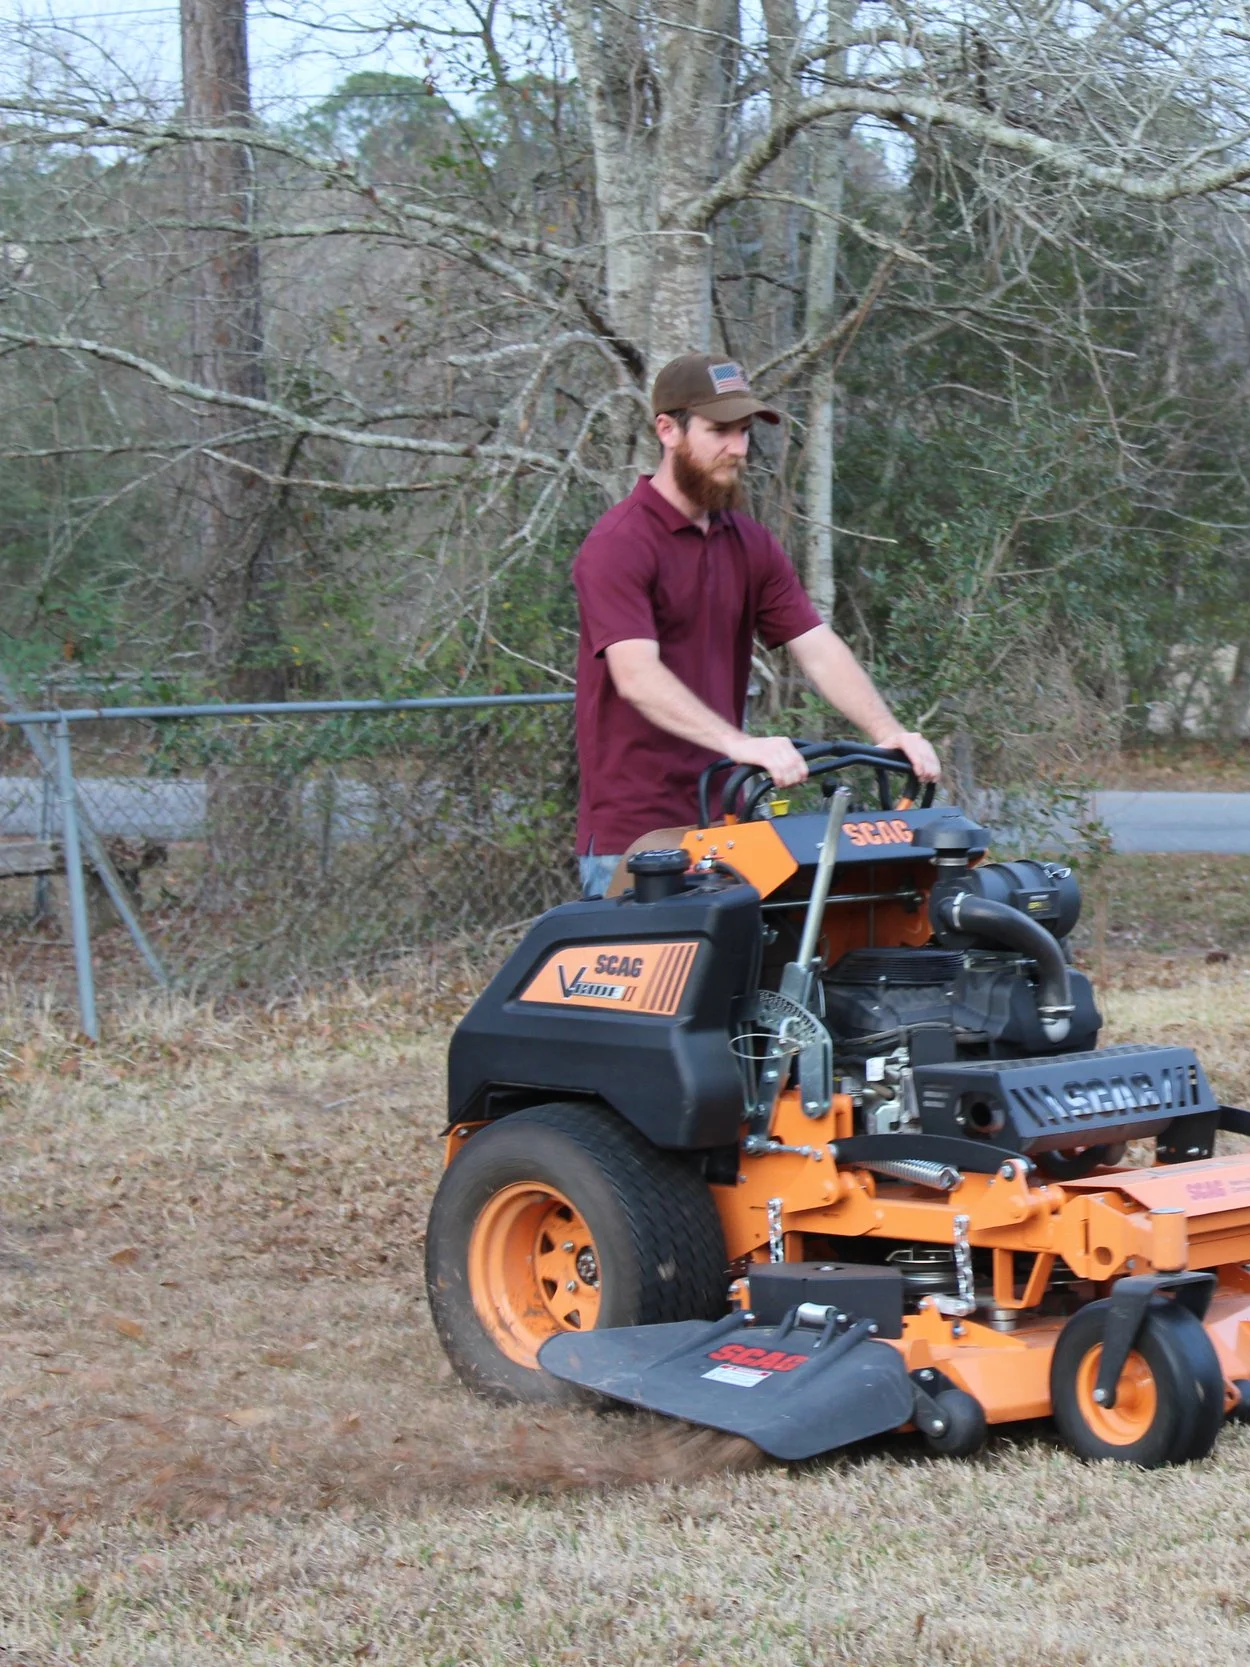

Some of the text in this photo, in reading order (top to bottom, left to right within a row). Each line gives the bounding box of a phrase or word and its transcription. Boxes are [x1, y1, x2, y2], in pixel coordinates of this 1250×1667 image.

[841, 818, 914, 847] SCAG
[595, 954, 643, 978] SCAG
[708, 1344, 809, 1372] SCAG
